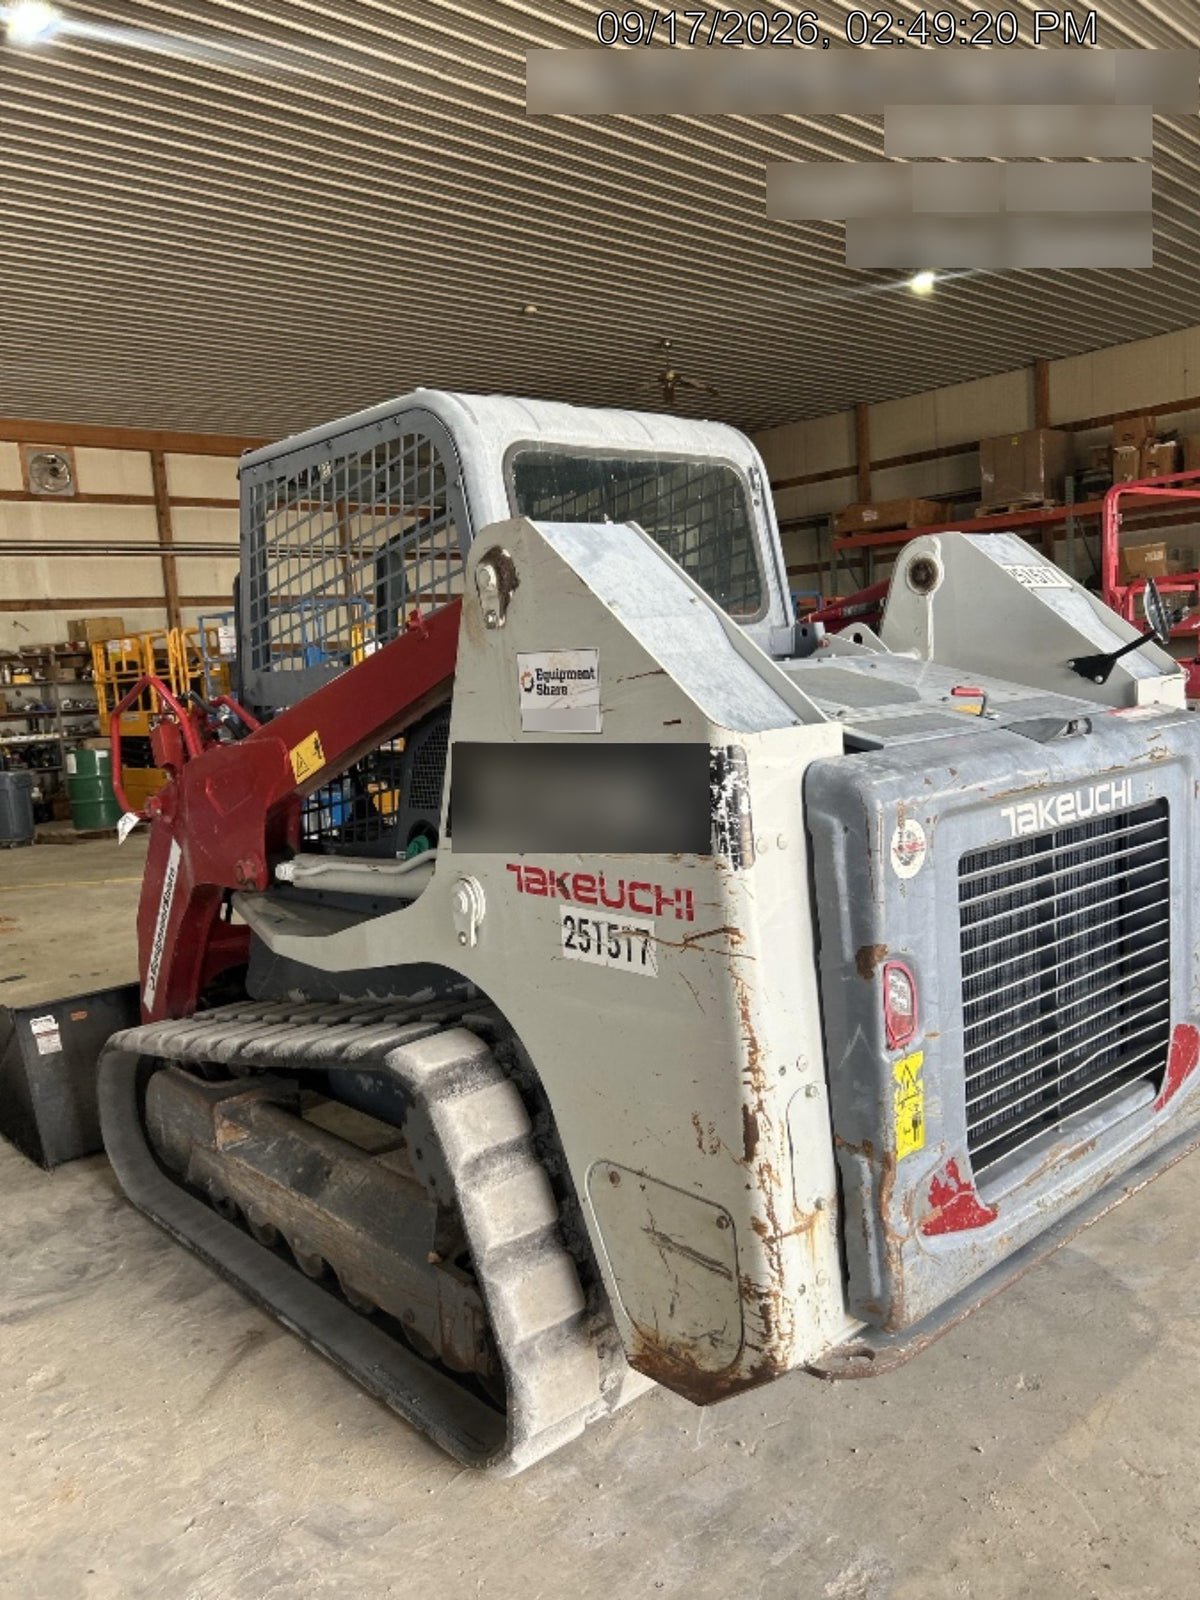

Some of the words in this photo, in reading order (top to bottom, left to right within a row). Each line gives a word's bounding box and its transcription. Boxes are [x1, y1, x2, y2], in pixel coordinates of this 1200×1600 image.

[535, 667, 596, 683] Equipment
[536, 684, 568, 696] Share
[563, 915, 650, 965] 251517
